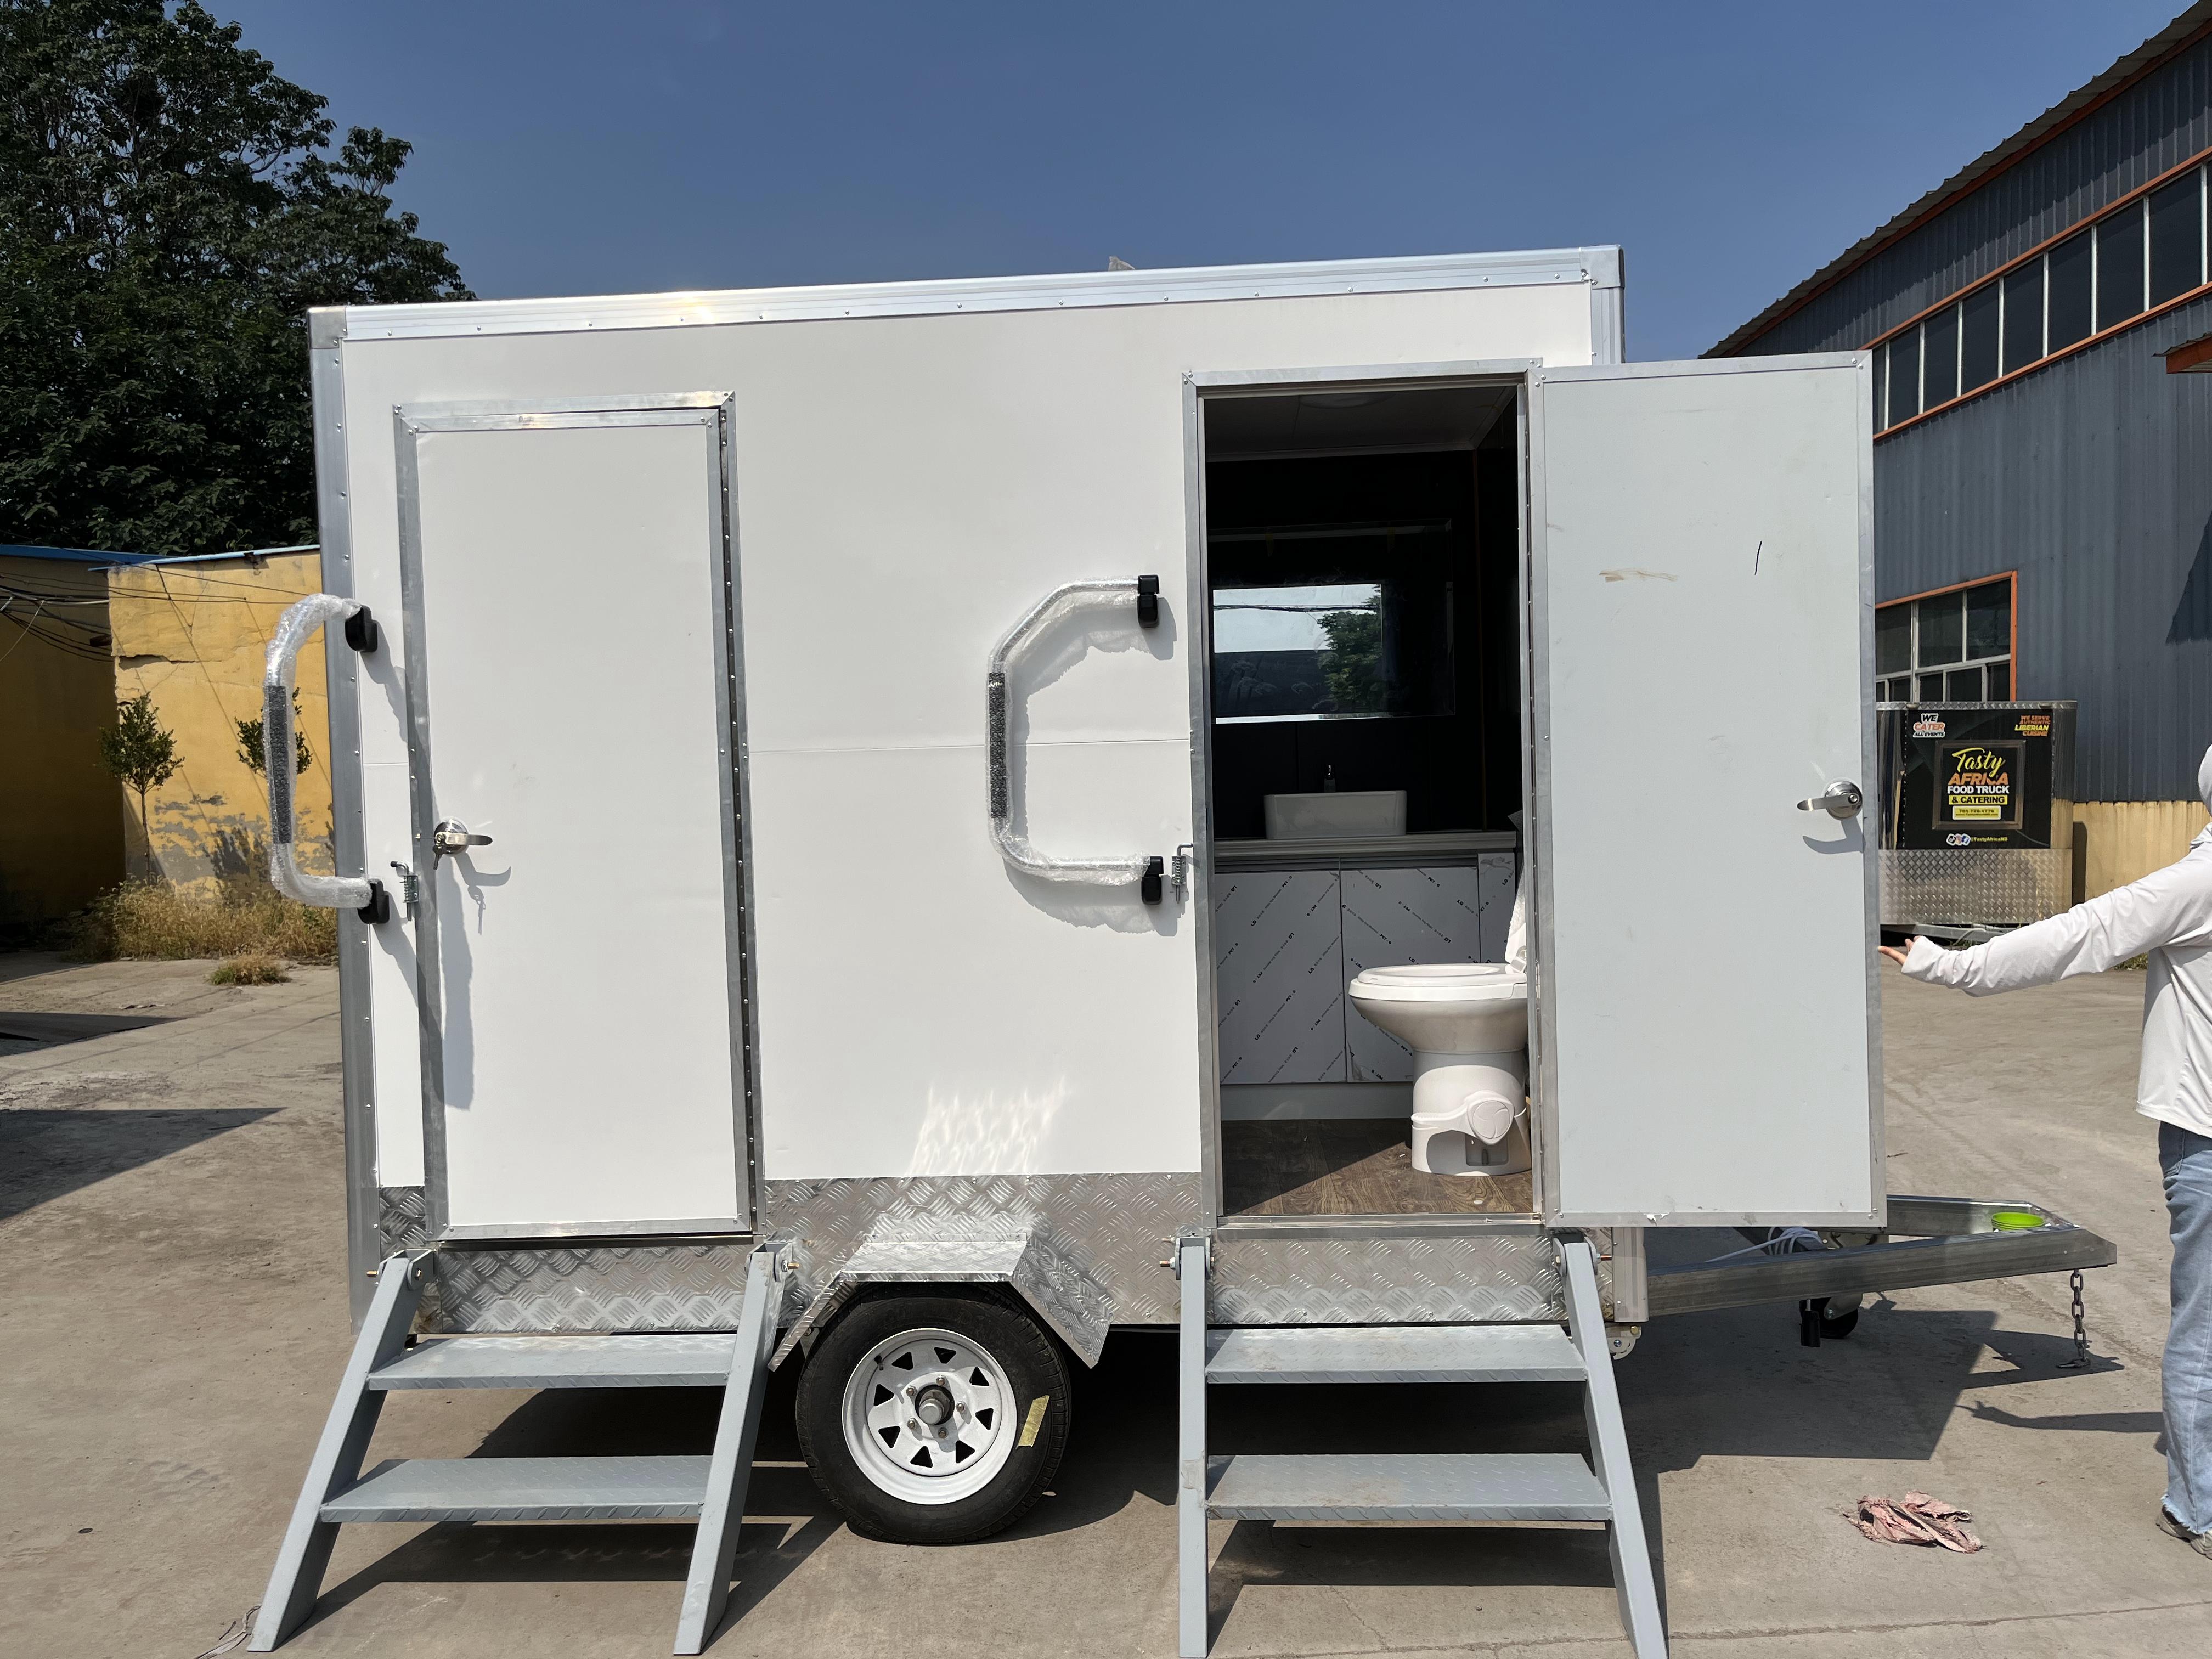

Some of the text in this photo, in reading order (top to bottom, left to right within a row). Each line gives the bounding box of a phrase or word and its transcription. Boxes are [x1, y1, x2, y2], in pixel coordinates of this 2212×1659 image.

[1952, 747, 2006, 777] Tasty
[1948, 772, 2008, 785] AFRICA
[1947, 785, 2010, 794] FOOD TRUCK
